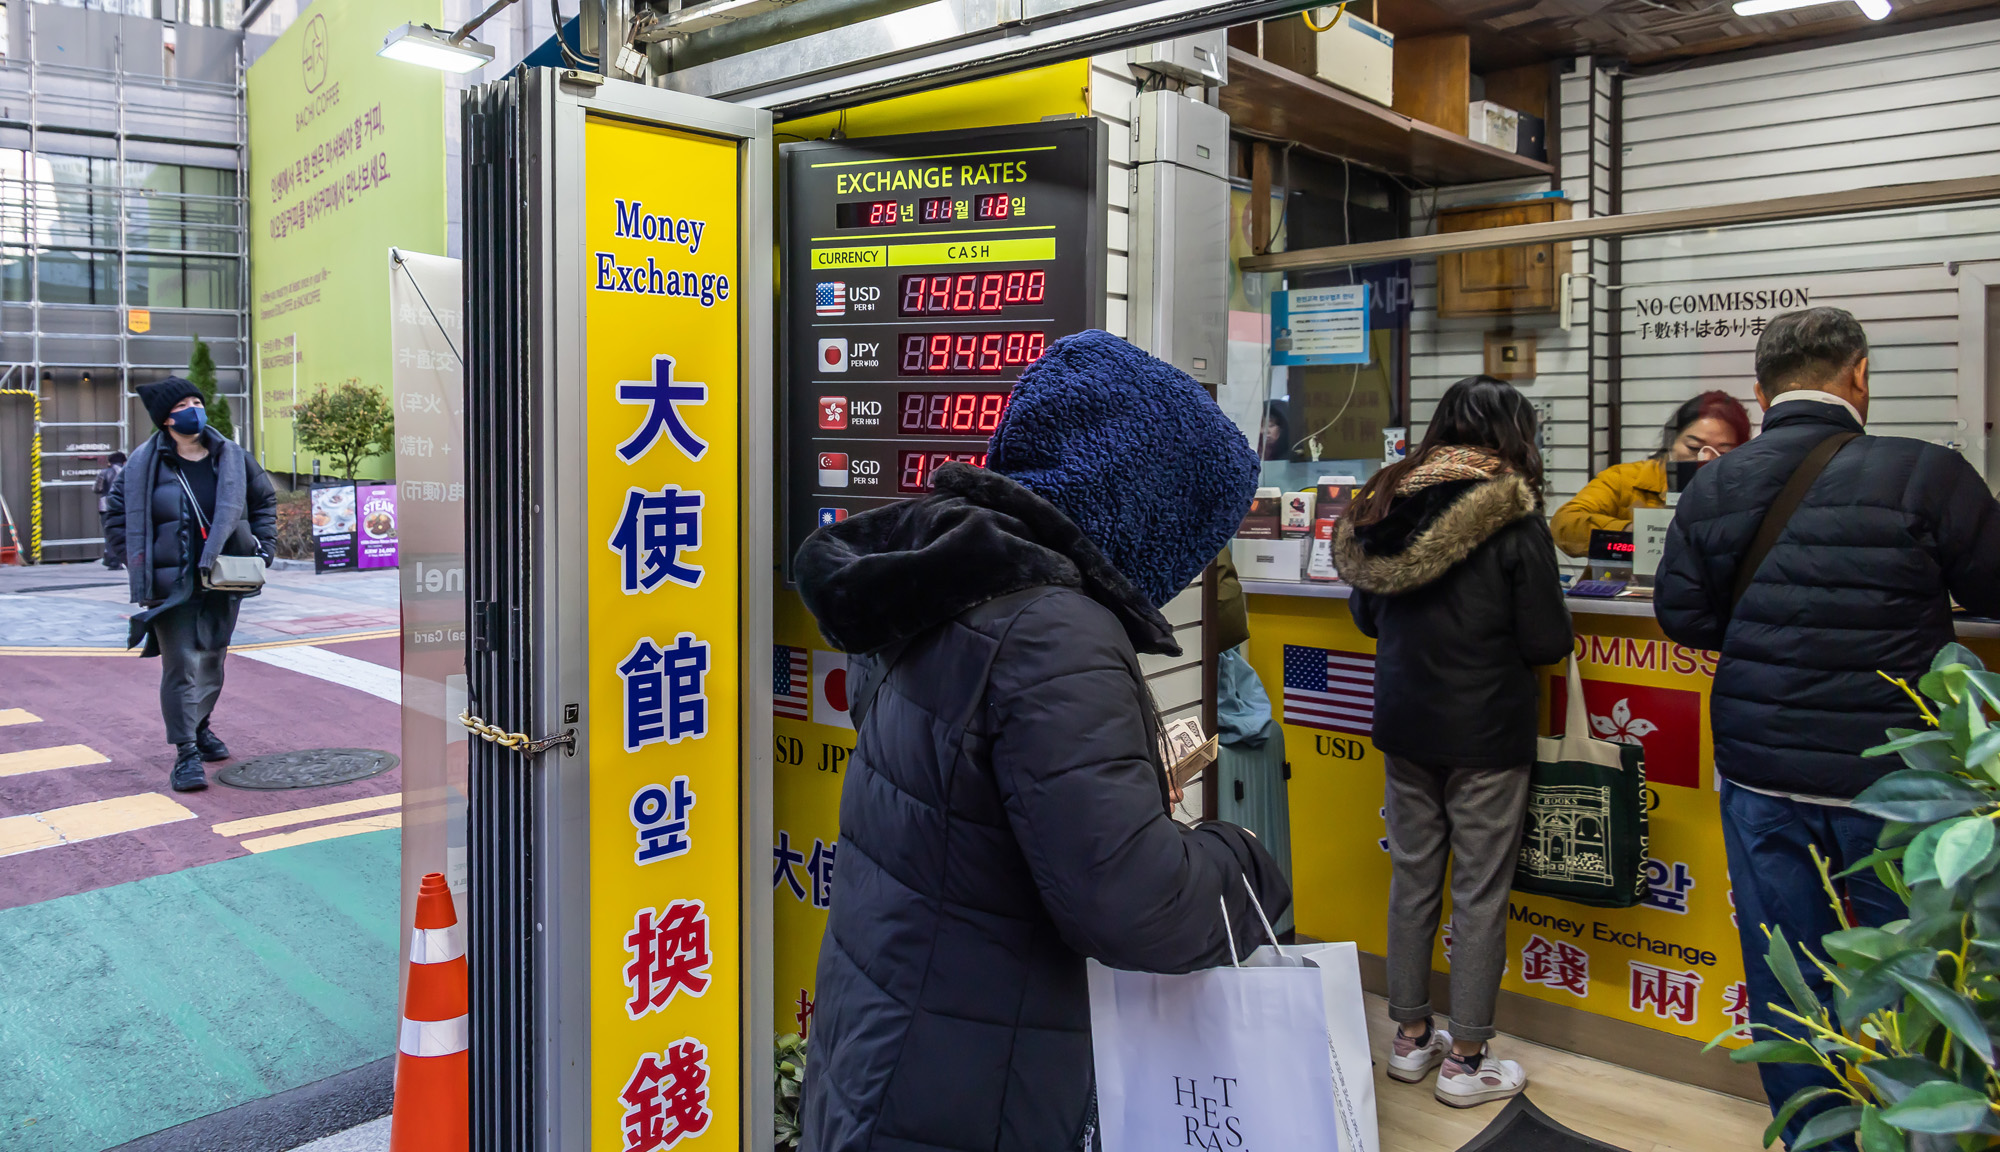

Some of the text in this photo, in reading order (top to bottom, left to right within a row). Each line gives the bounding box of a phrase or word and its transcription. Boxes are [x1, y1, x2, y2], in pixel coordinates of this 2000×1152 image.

[837, 162, 1027, 194] EXCHANGE RATES
[614, 199, 705, 254] Money
[818, 249, 879, 265] CURRENCY
[947, 245, 990, 259] CASH
[595, 253, 730, 307] Exchange
[849, 286, 880, 302] USD
[1636, 287, 1809, 317] NO COMMISSION
[850, 343, 880, 358] JPY
[851, 401, 882, 416] HKD
[940, 394, 1011, 430] 188
[851, 460, 880, 475] SGD
[363, 501, 395, 516] STEAK
[774, 734, 804, 766] SD
[1315, 734, 1365, 761] USD
[1544, 797, 1578, 806] BOOKS
[1510, 902, 1717, 967] Money Exchange
